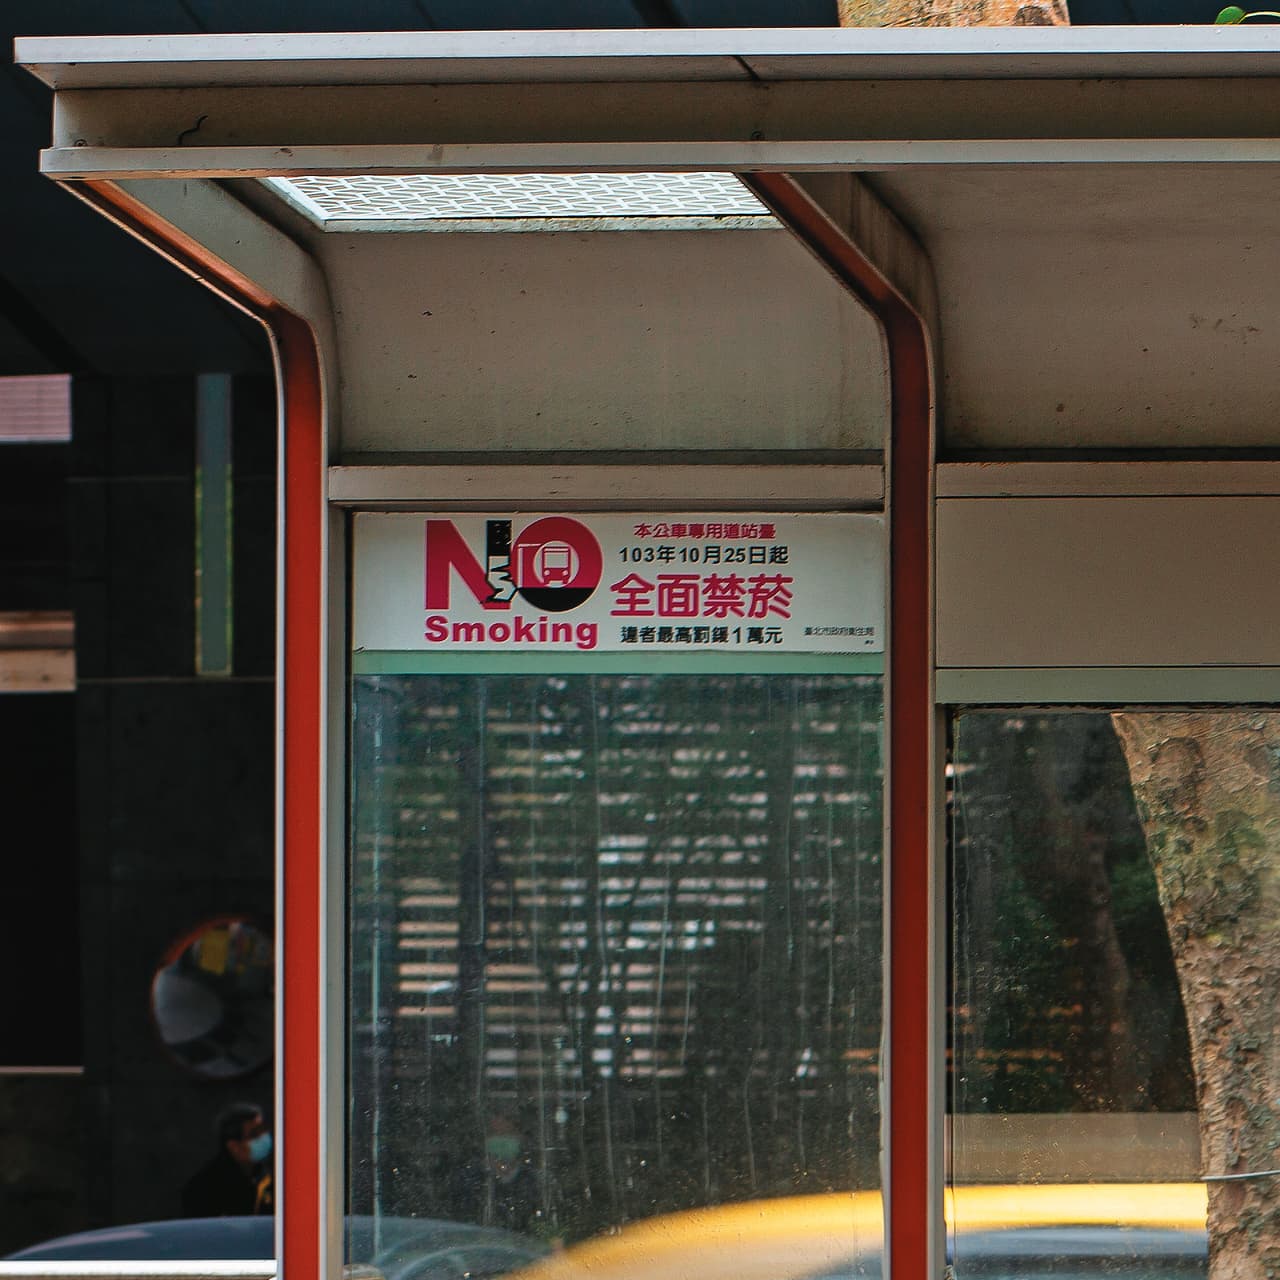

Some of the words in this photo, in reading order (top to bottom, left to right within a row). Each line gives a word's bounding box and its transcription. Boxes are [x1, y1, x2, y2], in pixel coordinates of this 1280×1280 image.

[425, 516, 604, 612] NO
[619, 545, 789, 564] 103年10月25日起
[610, 573, 794, 619] 全面禁菸
[425, 616, 598, 649] Smoking
